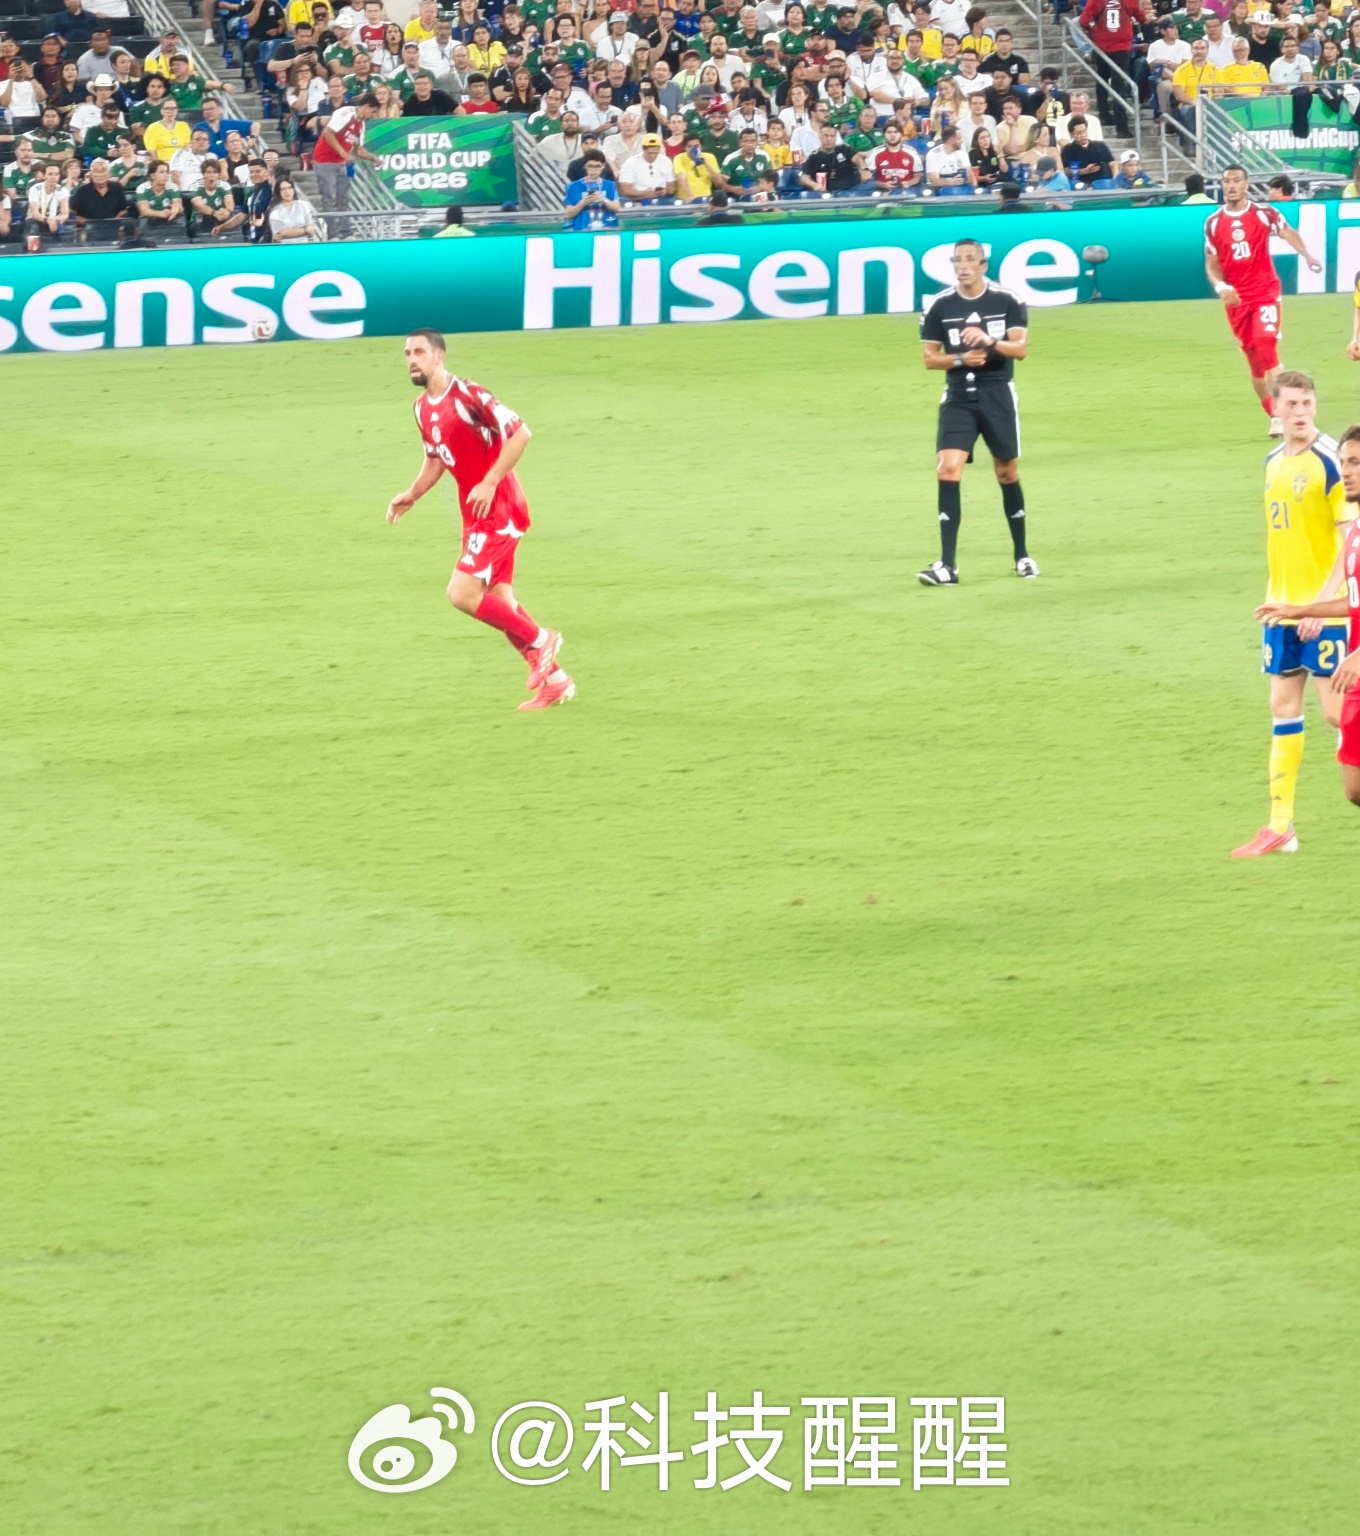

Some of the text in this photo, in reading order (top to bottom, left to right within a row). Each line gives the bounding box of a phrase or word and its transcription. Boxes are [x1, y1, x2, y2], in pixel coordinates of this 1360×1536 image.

[407, 132, 453, 150] FIFA
[449, 150, 491, 168] CUP
[394, 171, 468, 191] 2026
[1231, 240, 1251, 261] 20
[1259, 305, 1278, 323] 20
[1270, 500, 1290, 530] 21
[1317, 639, 1346, 670] 21
